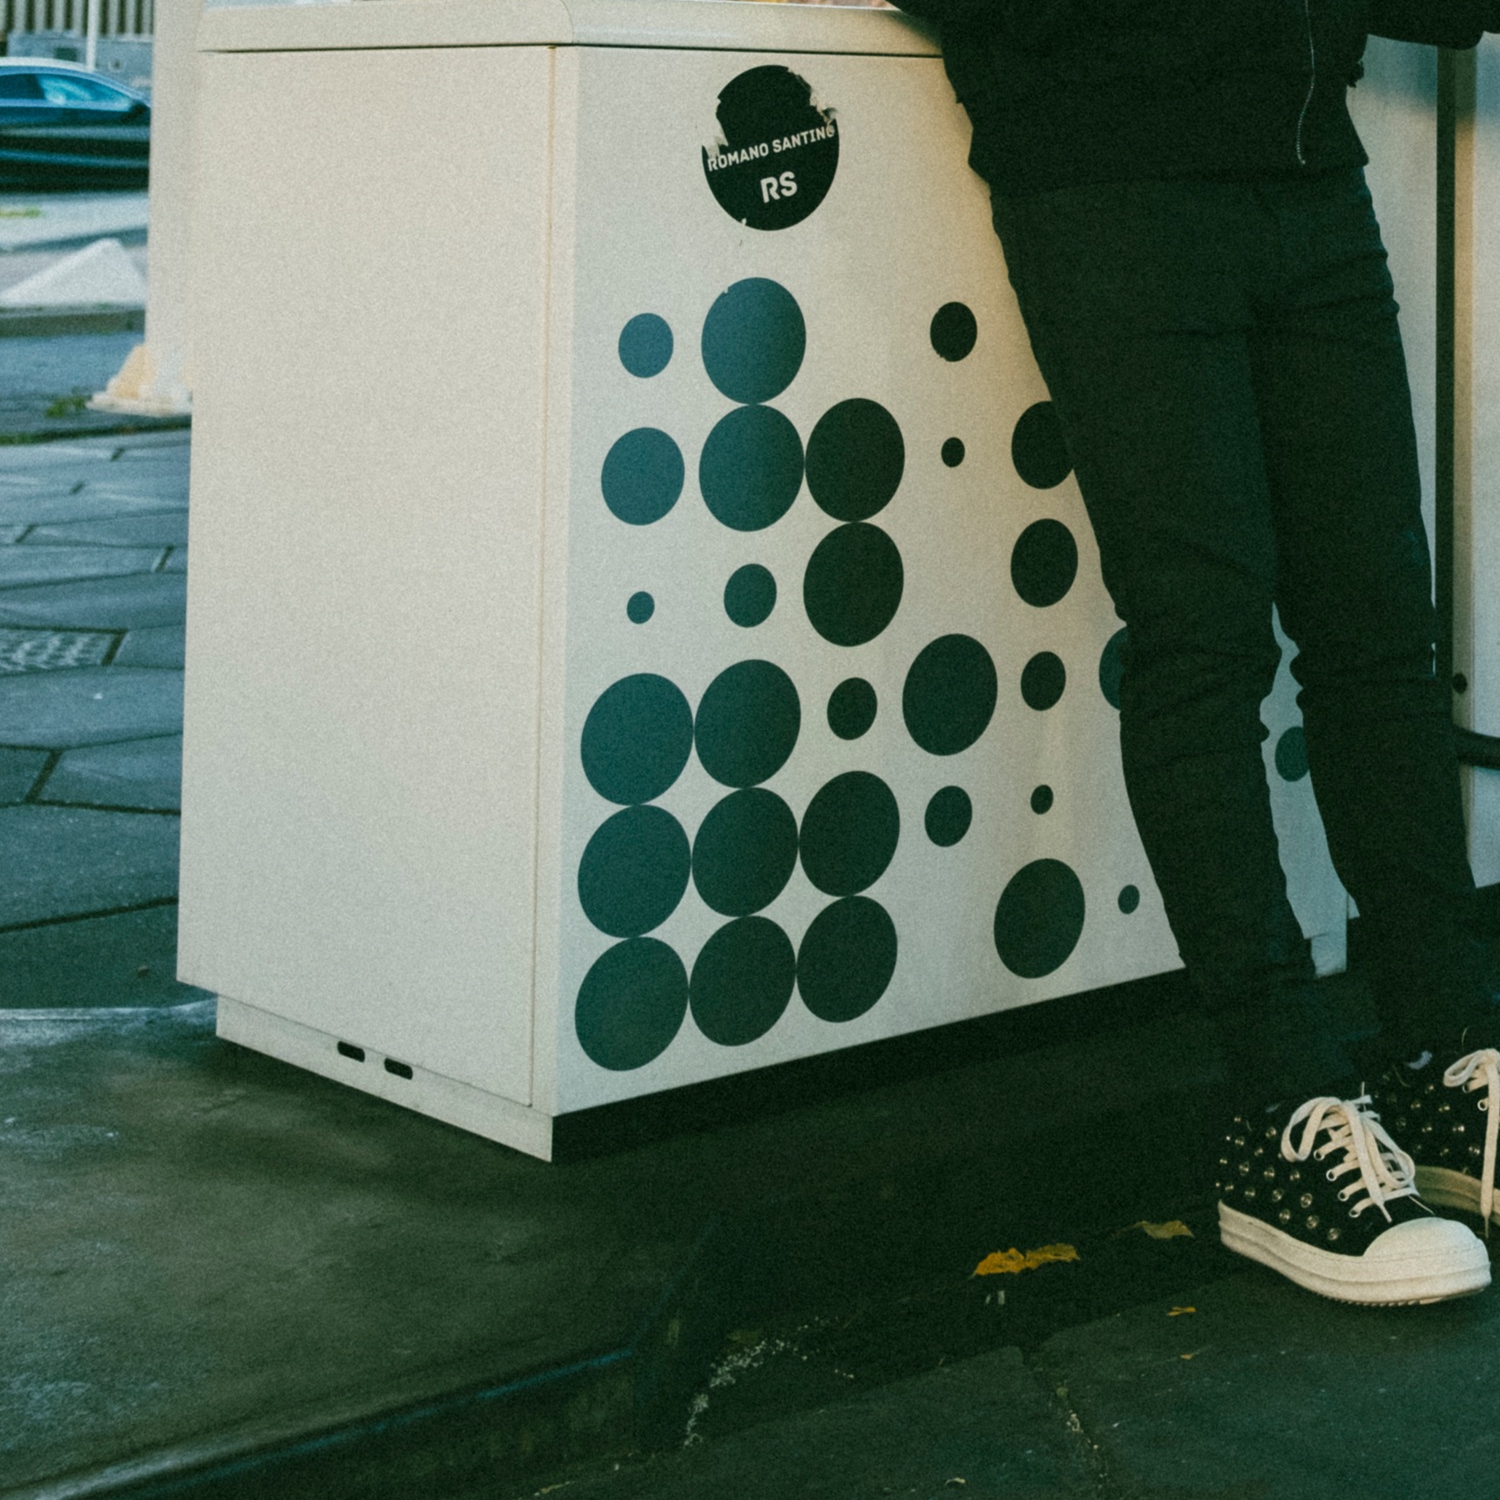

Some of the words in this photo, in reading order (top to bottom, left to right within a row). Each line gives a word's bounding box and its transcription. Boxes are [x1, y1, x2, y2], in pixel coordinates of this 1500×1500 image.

[707, 143, 769, 172] ROMANO
[772, 124, 835, 153] SANTINO
[760, 171, 798, 203] RS
